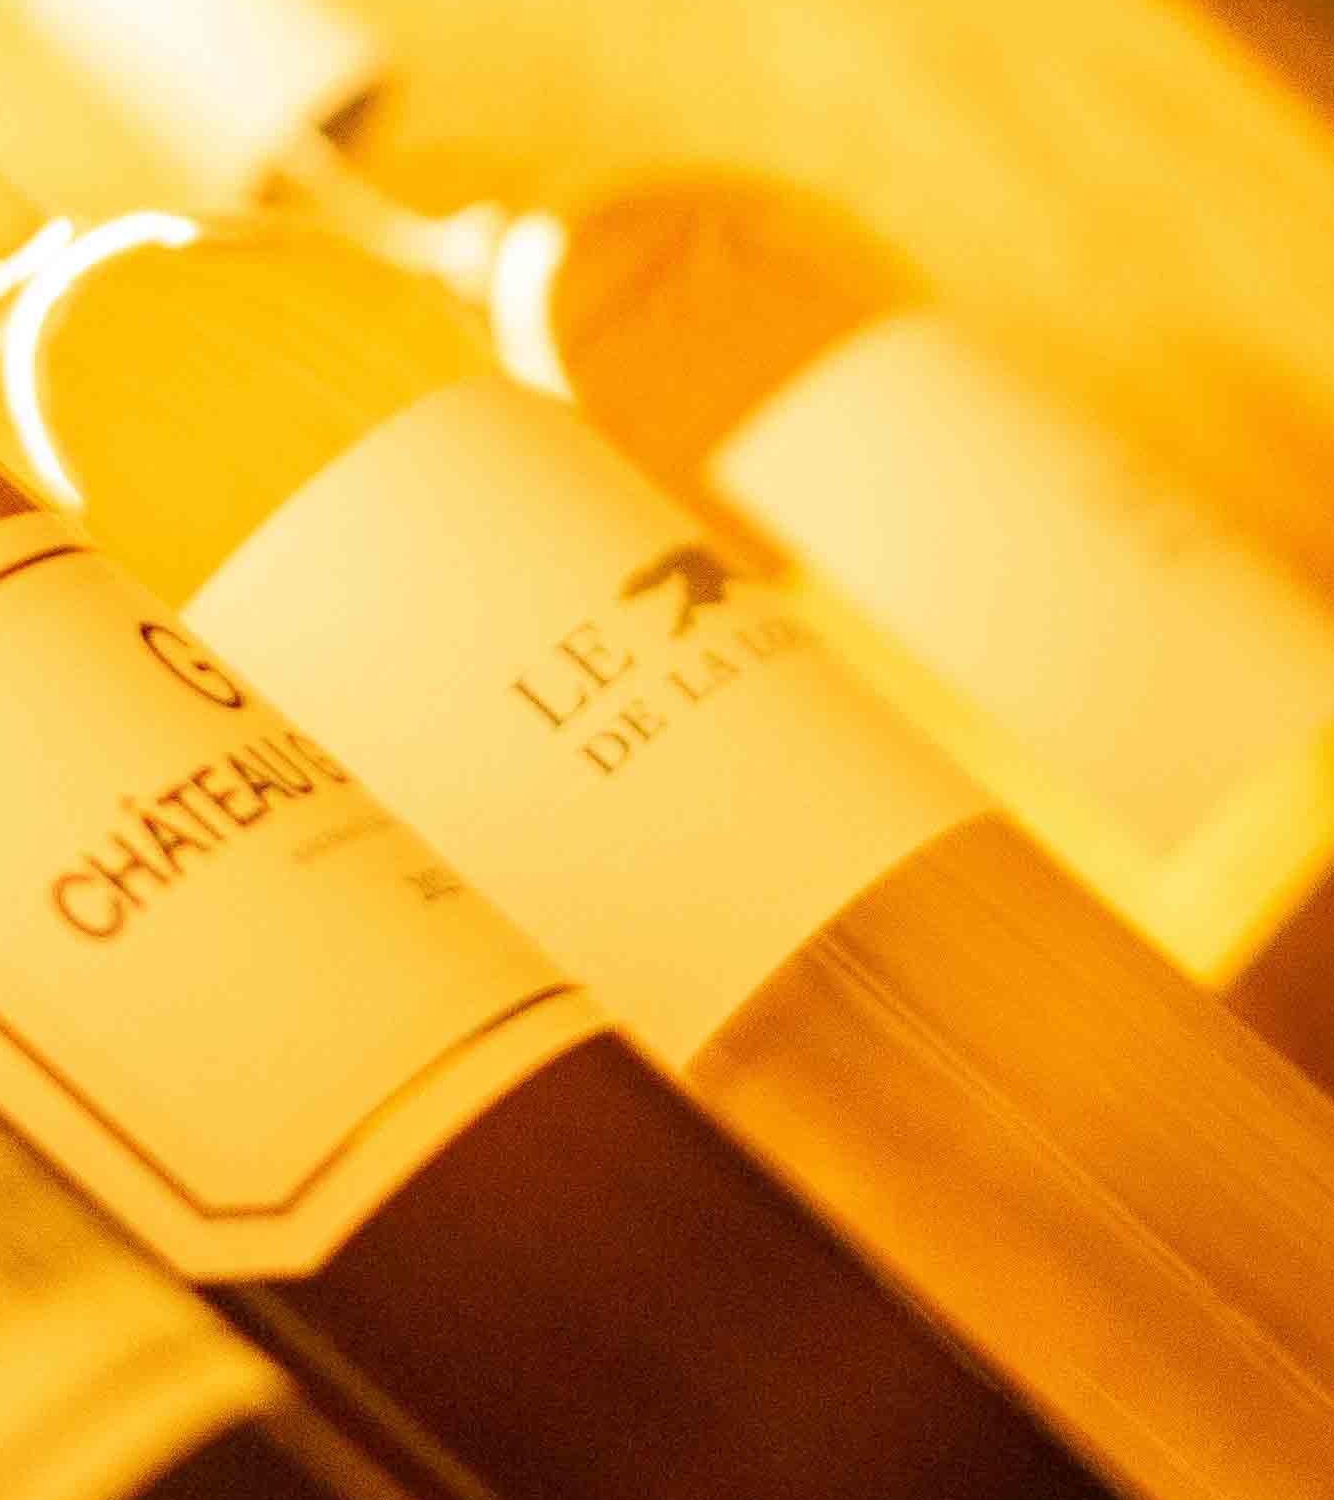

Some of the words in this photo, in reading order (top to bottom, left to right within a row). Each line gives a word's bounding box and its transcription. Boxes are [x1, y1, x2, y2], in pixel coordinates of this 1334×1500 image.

[138, 621, 244, 708] G
[508, 617, 634, 728] LE
[578, 698, 667, 774] DE
[667, 649, 743, 701] LA
